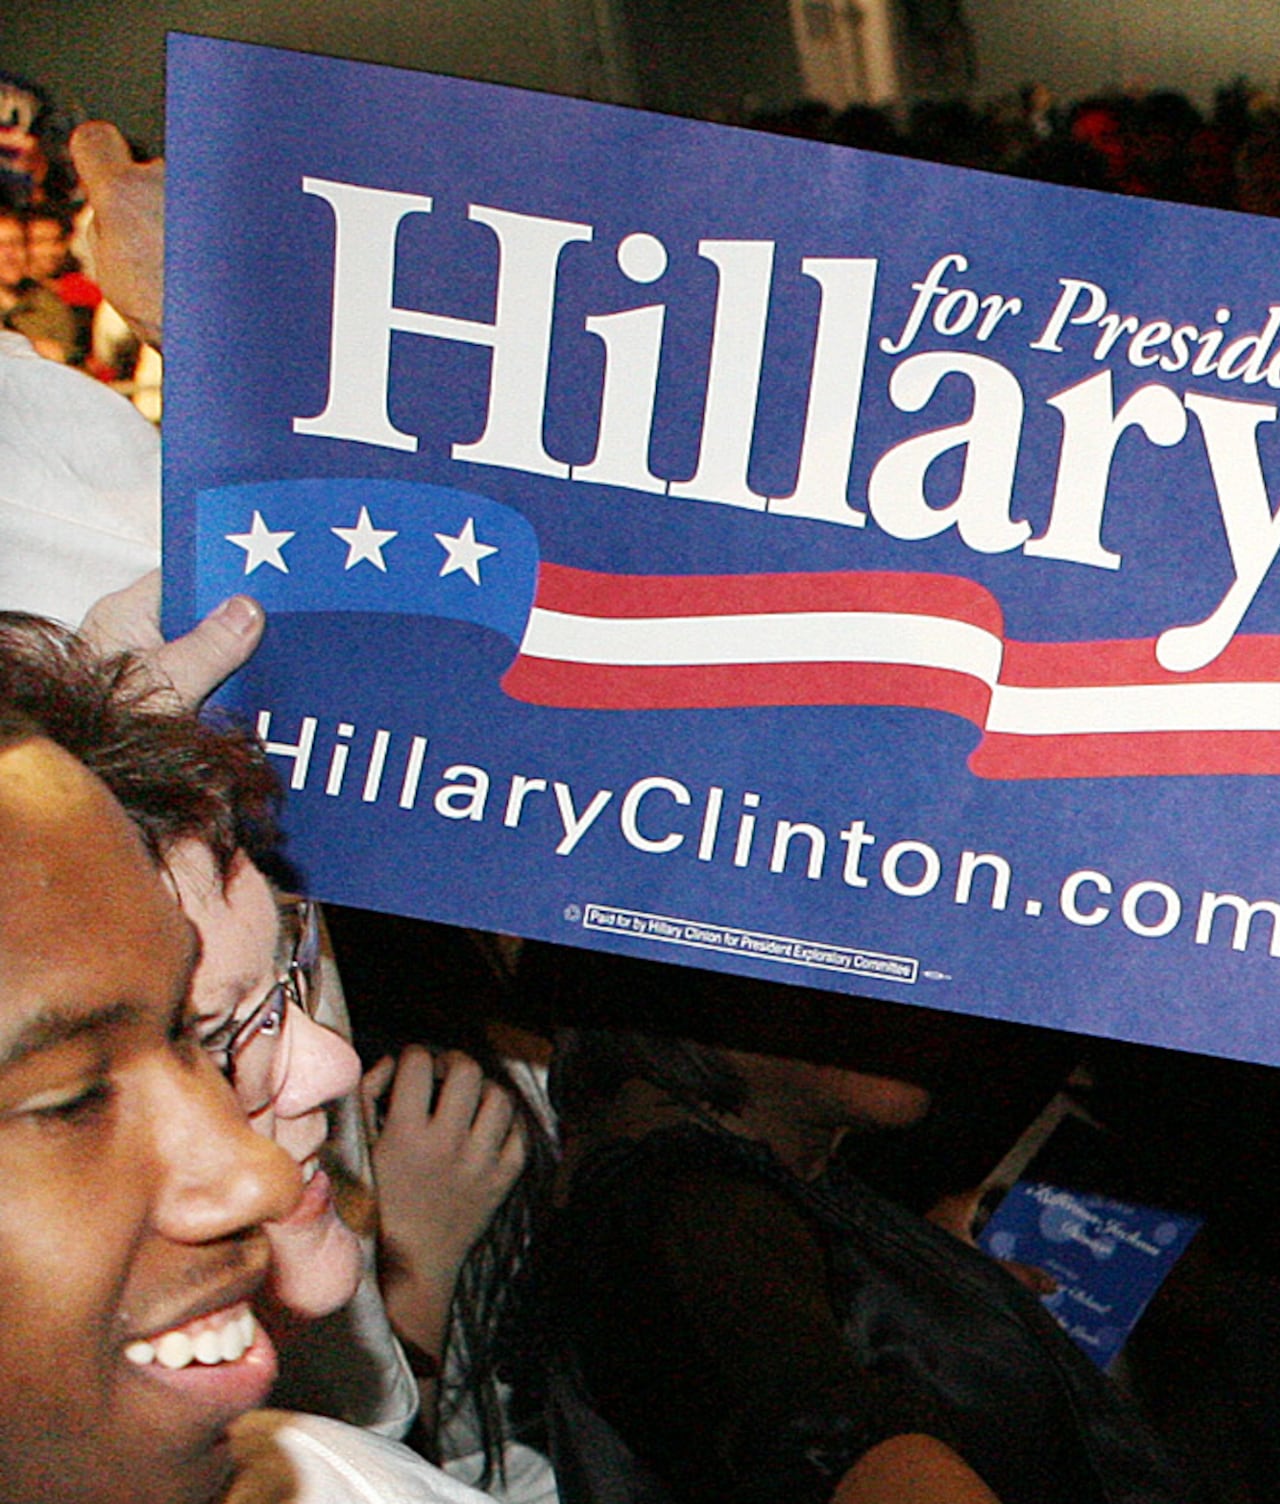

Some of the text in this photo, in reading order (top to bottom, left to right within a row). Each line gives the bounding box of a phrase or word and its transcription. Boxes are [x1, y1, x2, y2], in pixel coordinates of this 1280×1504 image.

[879, 254, 1022, 354] for
[590, 909, 616, 924] Paid
[616, 914, 632, 928] for
[648, 920, 683, 938] Hillary
[684, 926, 722, 944] Clinton
[723, 932, 740, 946] for
[740, 936, 793, 957] President
